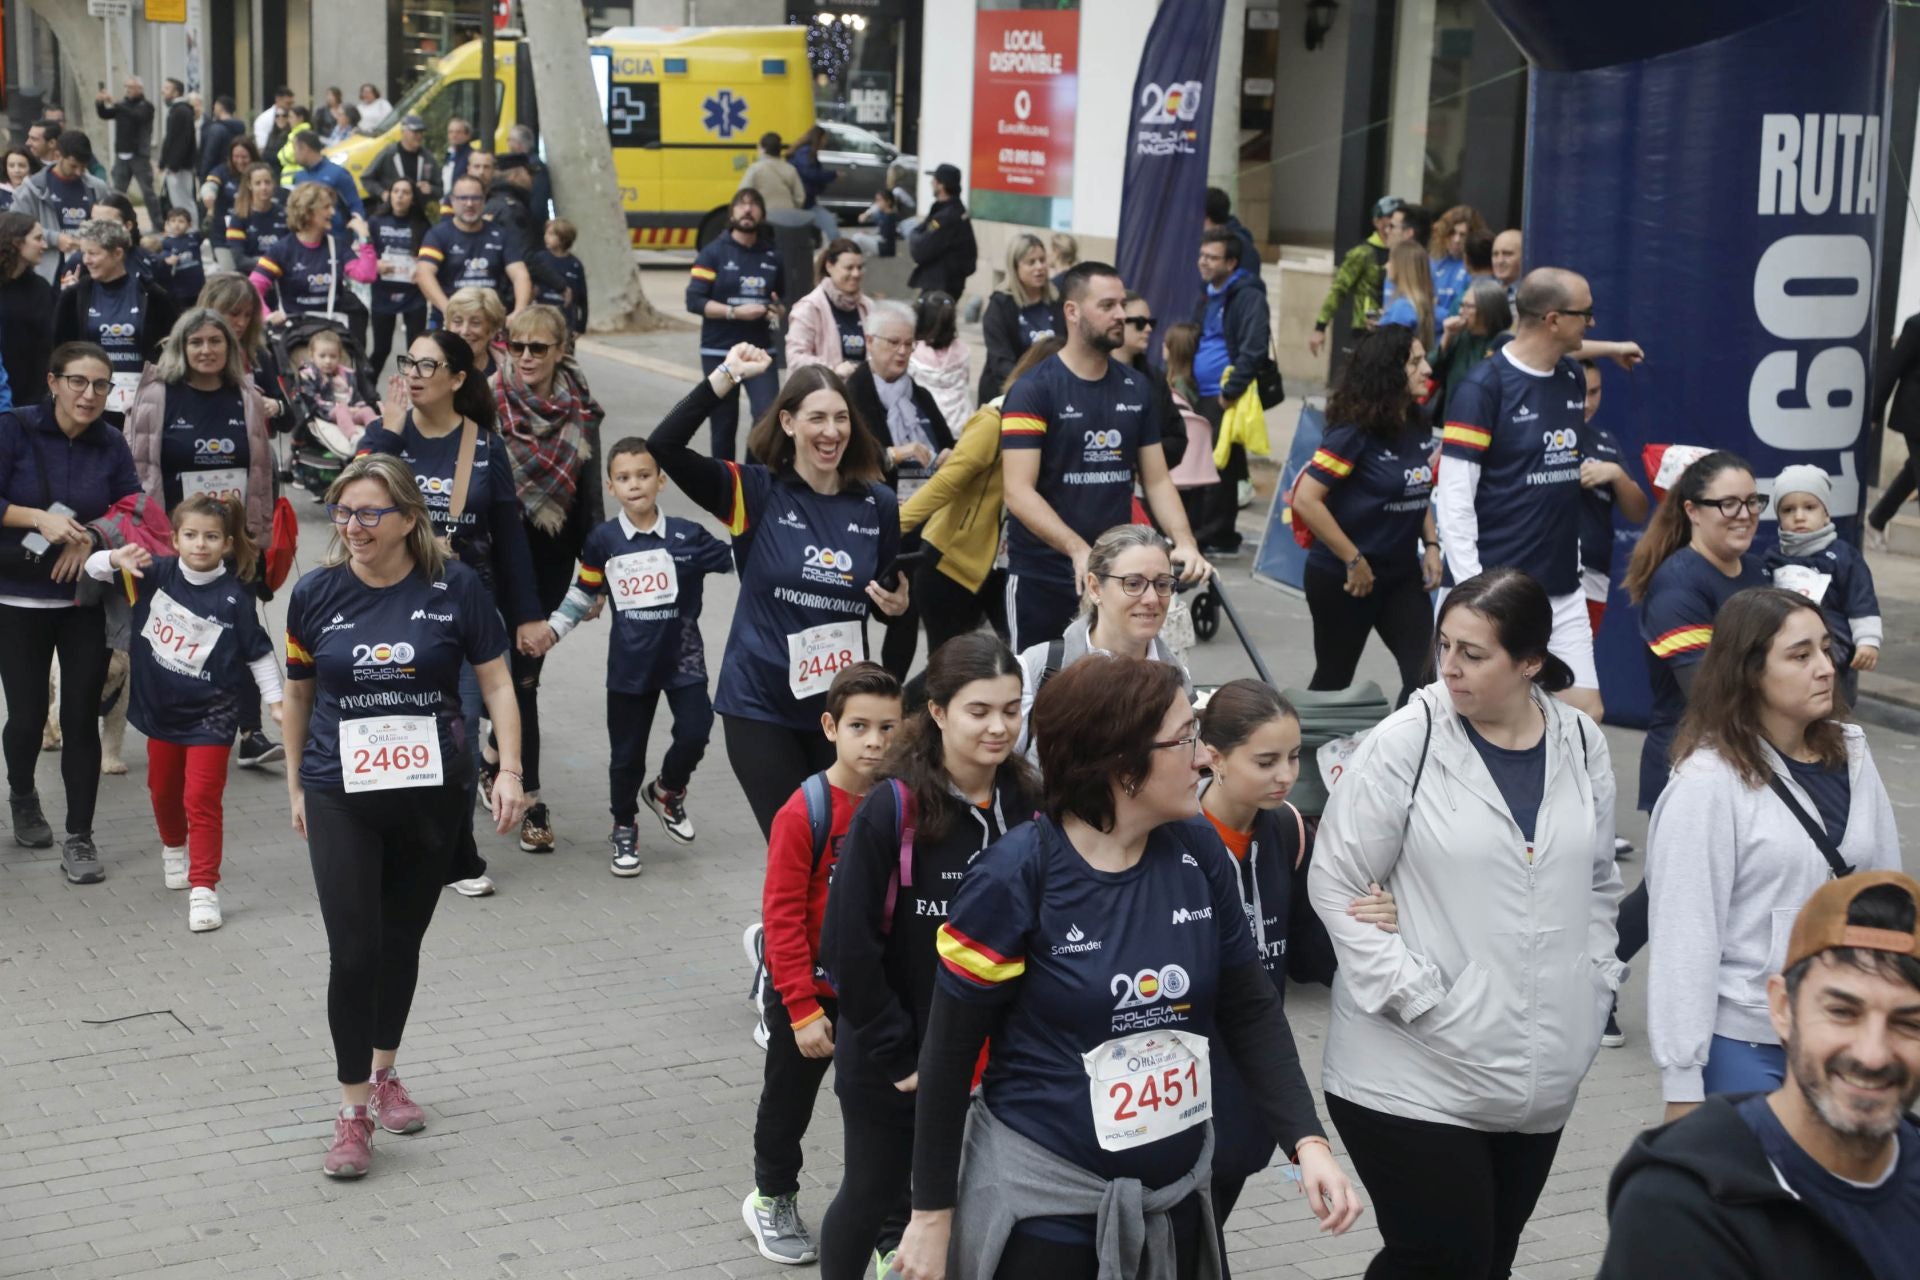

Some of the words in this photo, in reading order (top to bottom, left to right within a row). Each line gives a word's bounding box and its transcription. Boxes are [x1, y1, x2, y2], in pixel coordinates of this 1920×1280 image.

[1003, 29, 1045, 51] LOCAL
[989, 52, 1062, 74] DISPONIBLE
[1140, 80, 1202, 124] 200
[1758, 113, 1880, 215] RUTA
[99, 323, 136, 337] 200
[194, 438, 235, 455] 200
[1083, 429, 1122, 450] 200
[1543, 428, 1577, 452] 200
[804, 544, 853, 572] 200
[802, 566, 843, 579] POLICIA
[802, 572, 853, 588] NACIONAL
[618, 571, 668, 597] 3220
[427, 612, 453, 622] mupol
[153, 616, 199, 660] 3011
[352, 642, 415, 667] 200
[799, 649, 853, 682] 2448
[353, 667, 402, 676] POLICIA
[354, 673, 415, 682] NACIONAL
[339, 690, 442, 709] #YOCORROCONLUCA
[353, 744, 429, 774] 2469
[1051, 940, 1102, 956] Santander
[1110, 963, 1190, 1011] 200
[1111, 1005, 1174, 1024] POLICIA
[1111, 1013, 1189, 1032] NACIONAL
[1109, 1061, 1198, 1121] 2451
